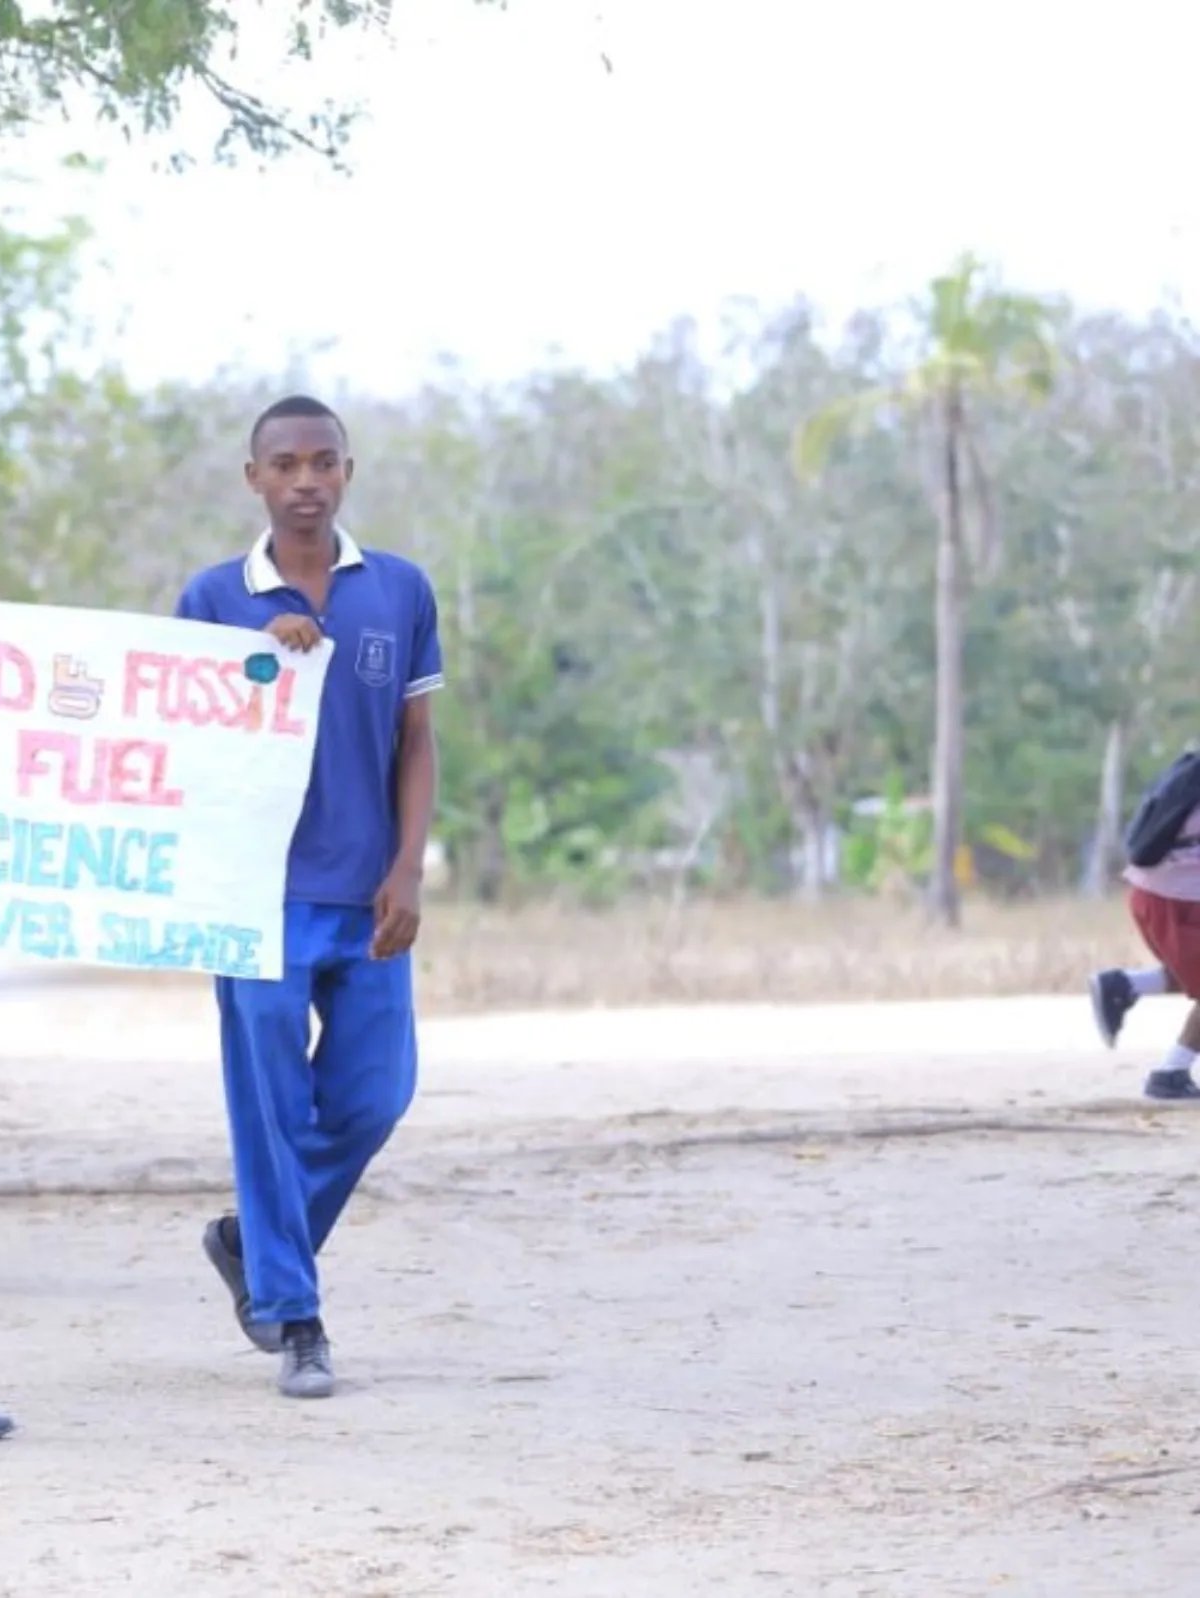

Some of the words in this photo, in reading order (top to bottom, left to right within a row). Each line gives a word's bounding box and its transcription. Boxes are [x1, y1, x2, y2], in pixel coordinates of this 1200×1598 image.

[48, 653, 104, 720] OF
[17, 729, 184, 806] FUEL
[98, 912, 263, 978] SILENCE
